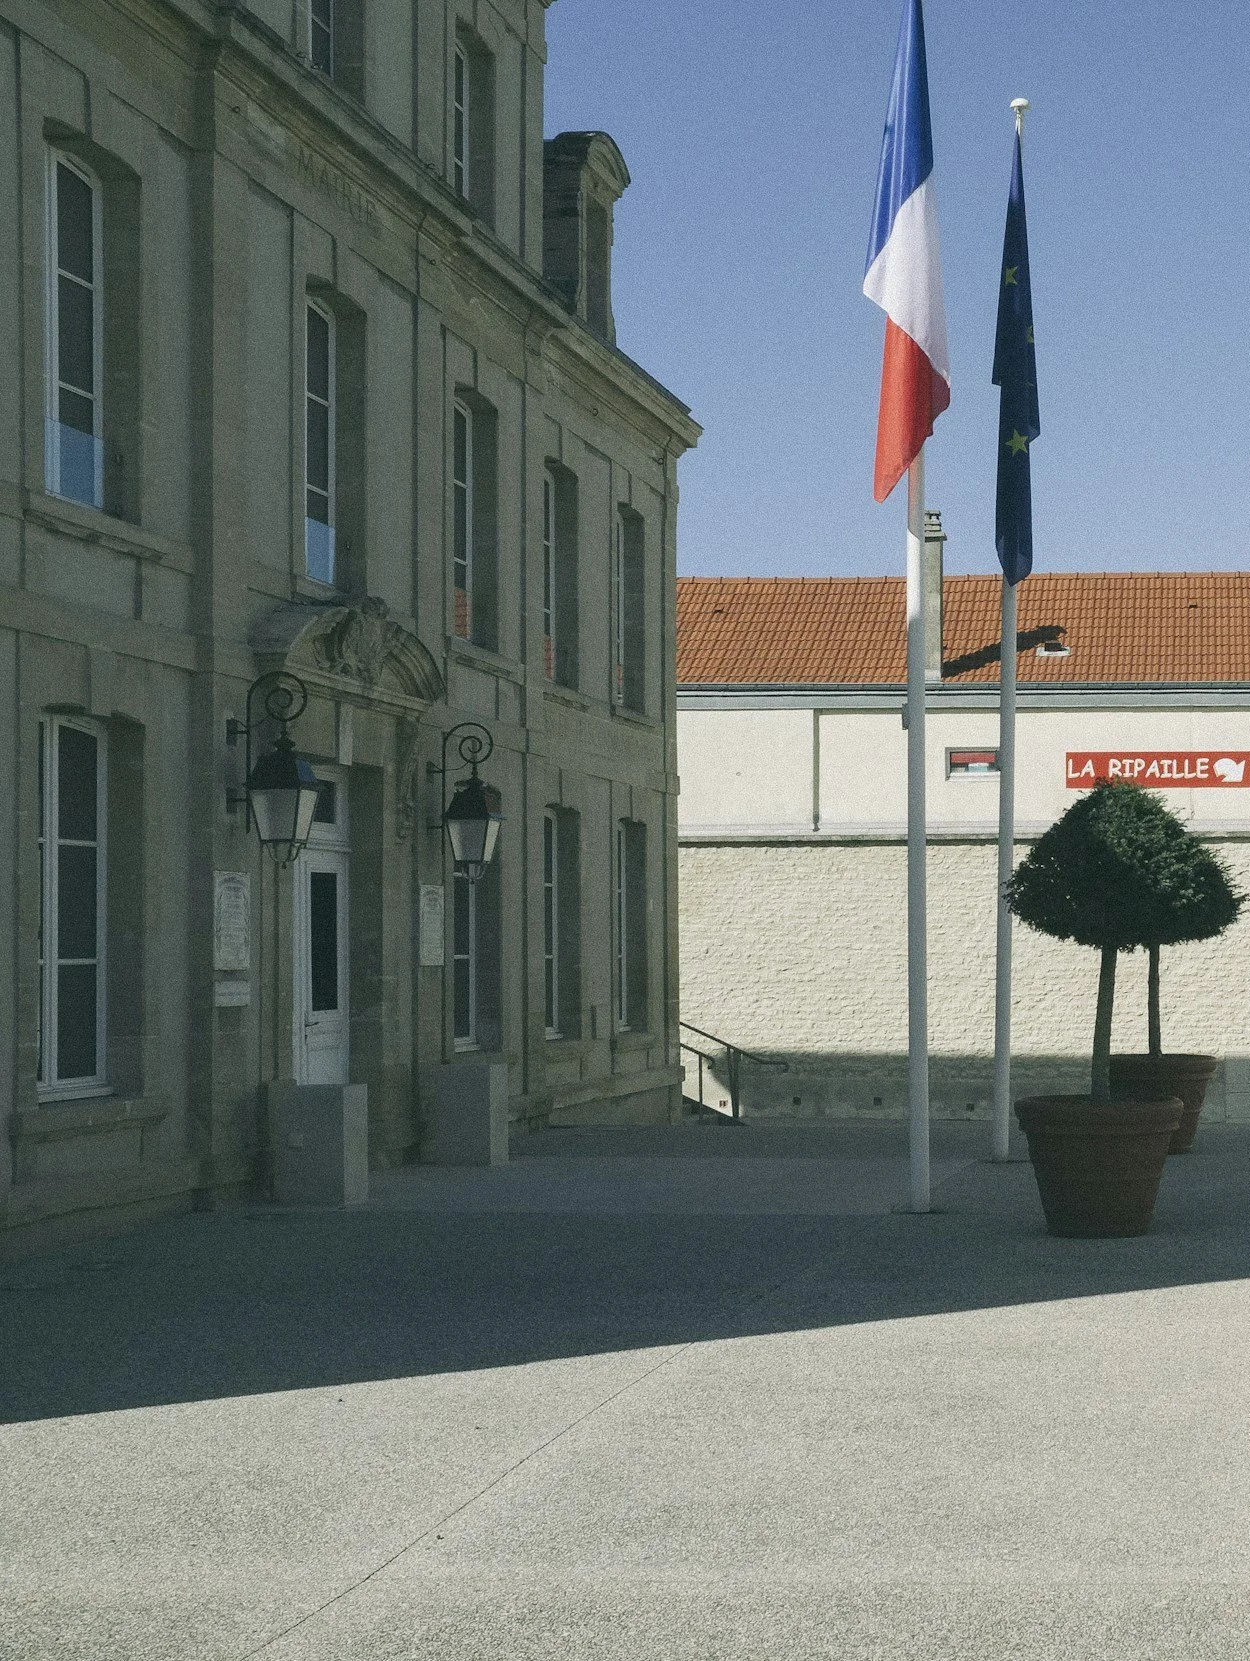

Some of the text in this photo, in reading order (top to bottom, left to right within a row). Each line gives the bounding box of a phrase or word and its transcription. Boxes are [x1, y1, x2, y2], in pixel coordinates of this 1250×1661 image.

[297, 146, 378, 229] MAIRIE
[1067, 757, 1210, 779] LA RIPAILLE
